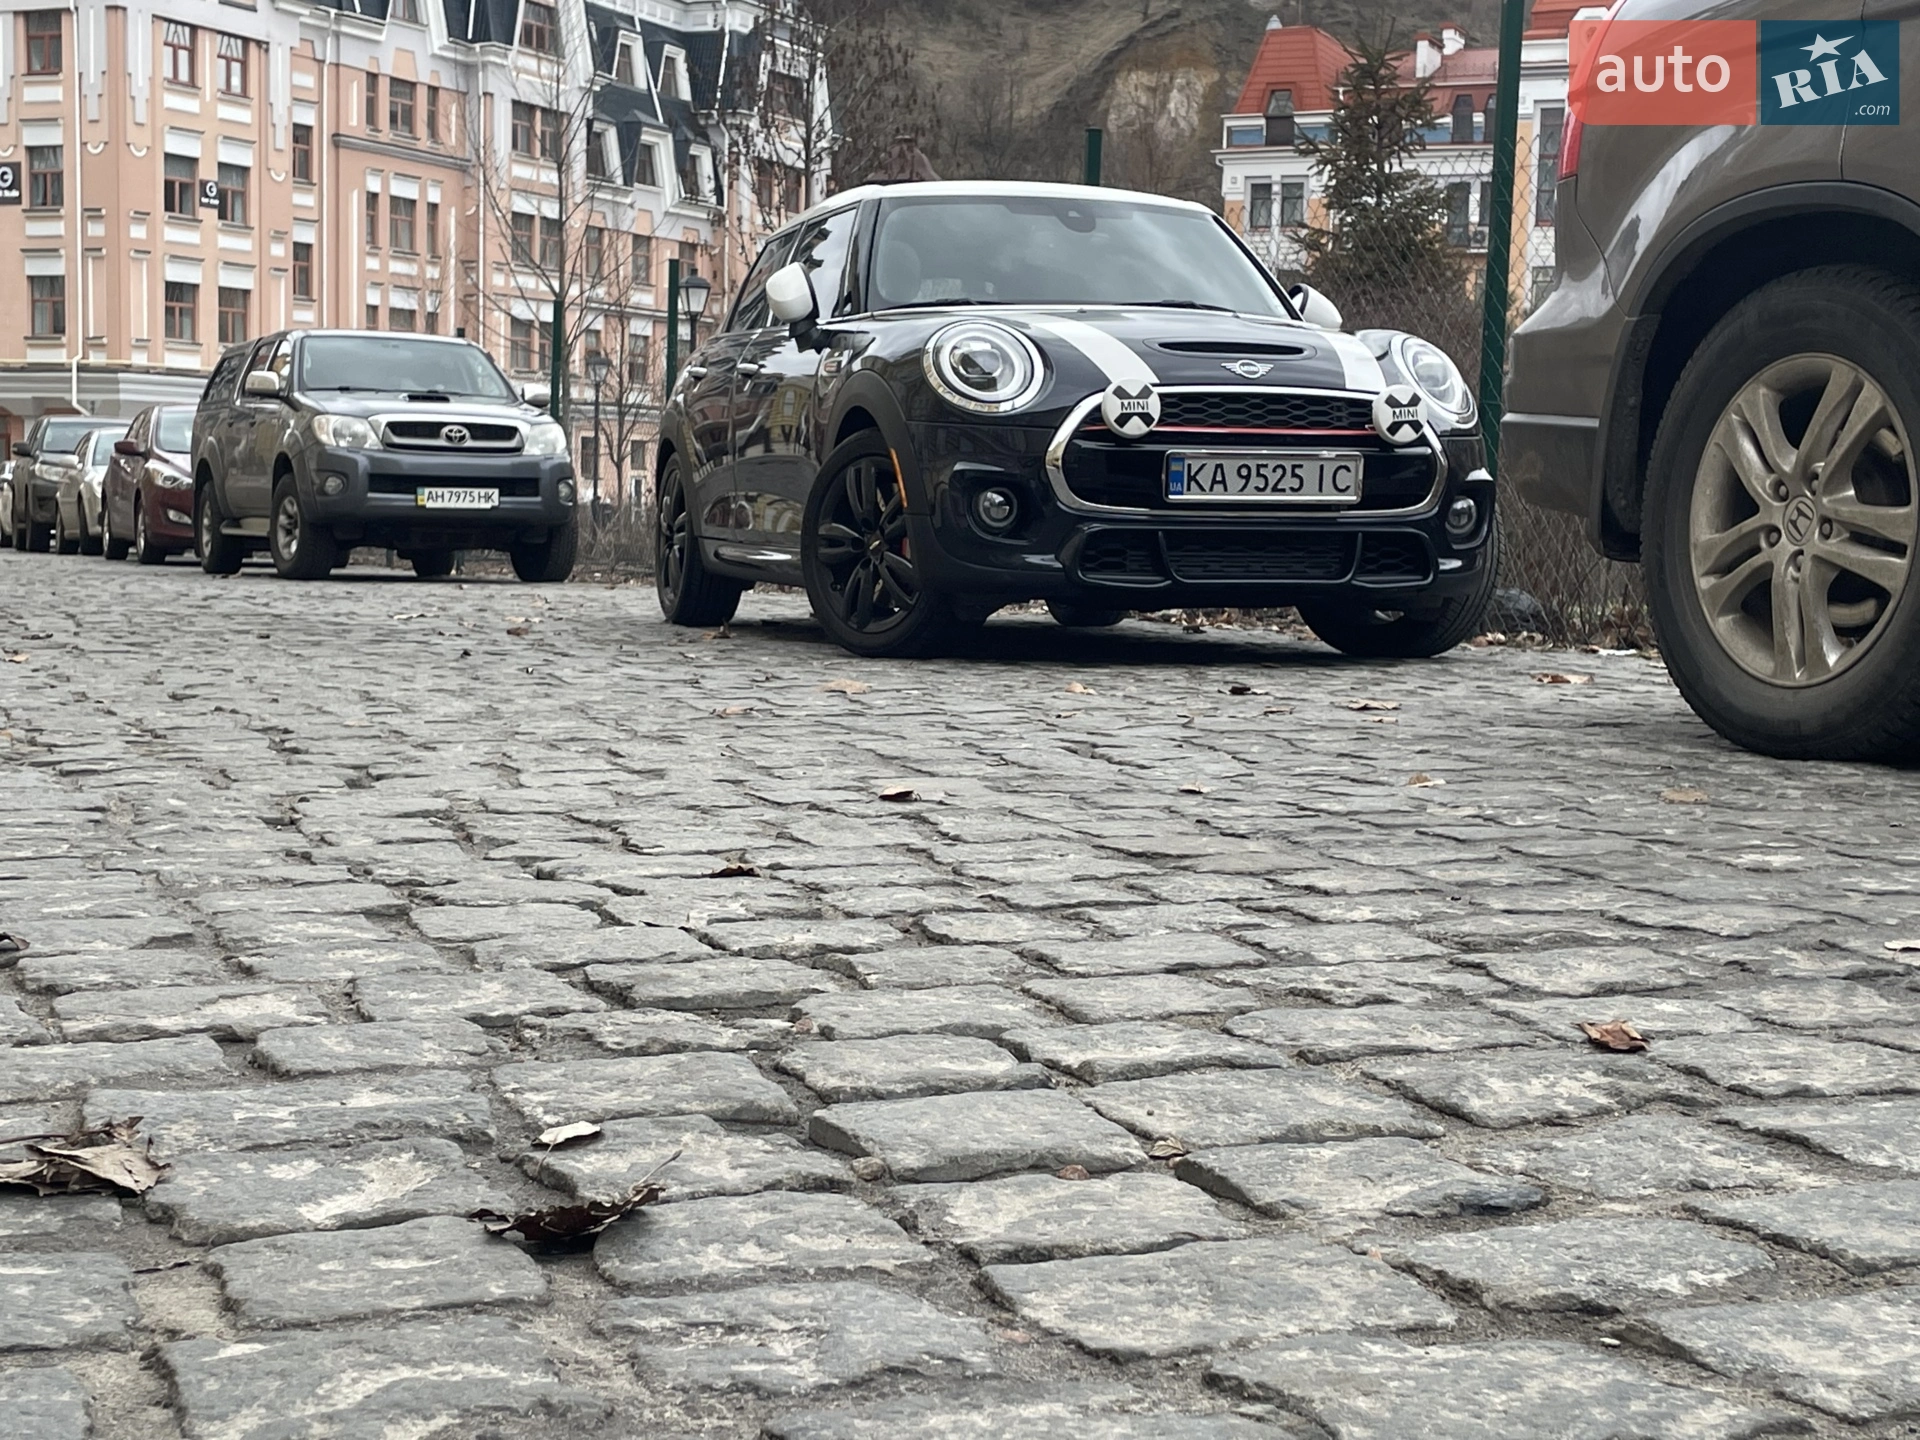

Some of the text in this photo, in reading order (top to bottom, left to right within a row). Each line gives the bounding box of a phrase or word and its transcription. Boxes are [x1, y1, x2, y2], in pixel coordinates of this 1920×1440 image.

[1120, 400, 1149, 411] MINI
[1392, 408, 1418, 420] MINI
[1186, 462, 1352, 493] KA 9525 IC
[1169, 482, 1183, 492] UA
[426, 490, 496, 503] AH 7975 HK
